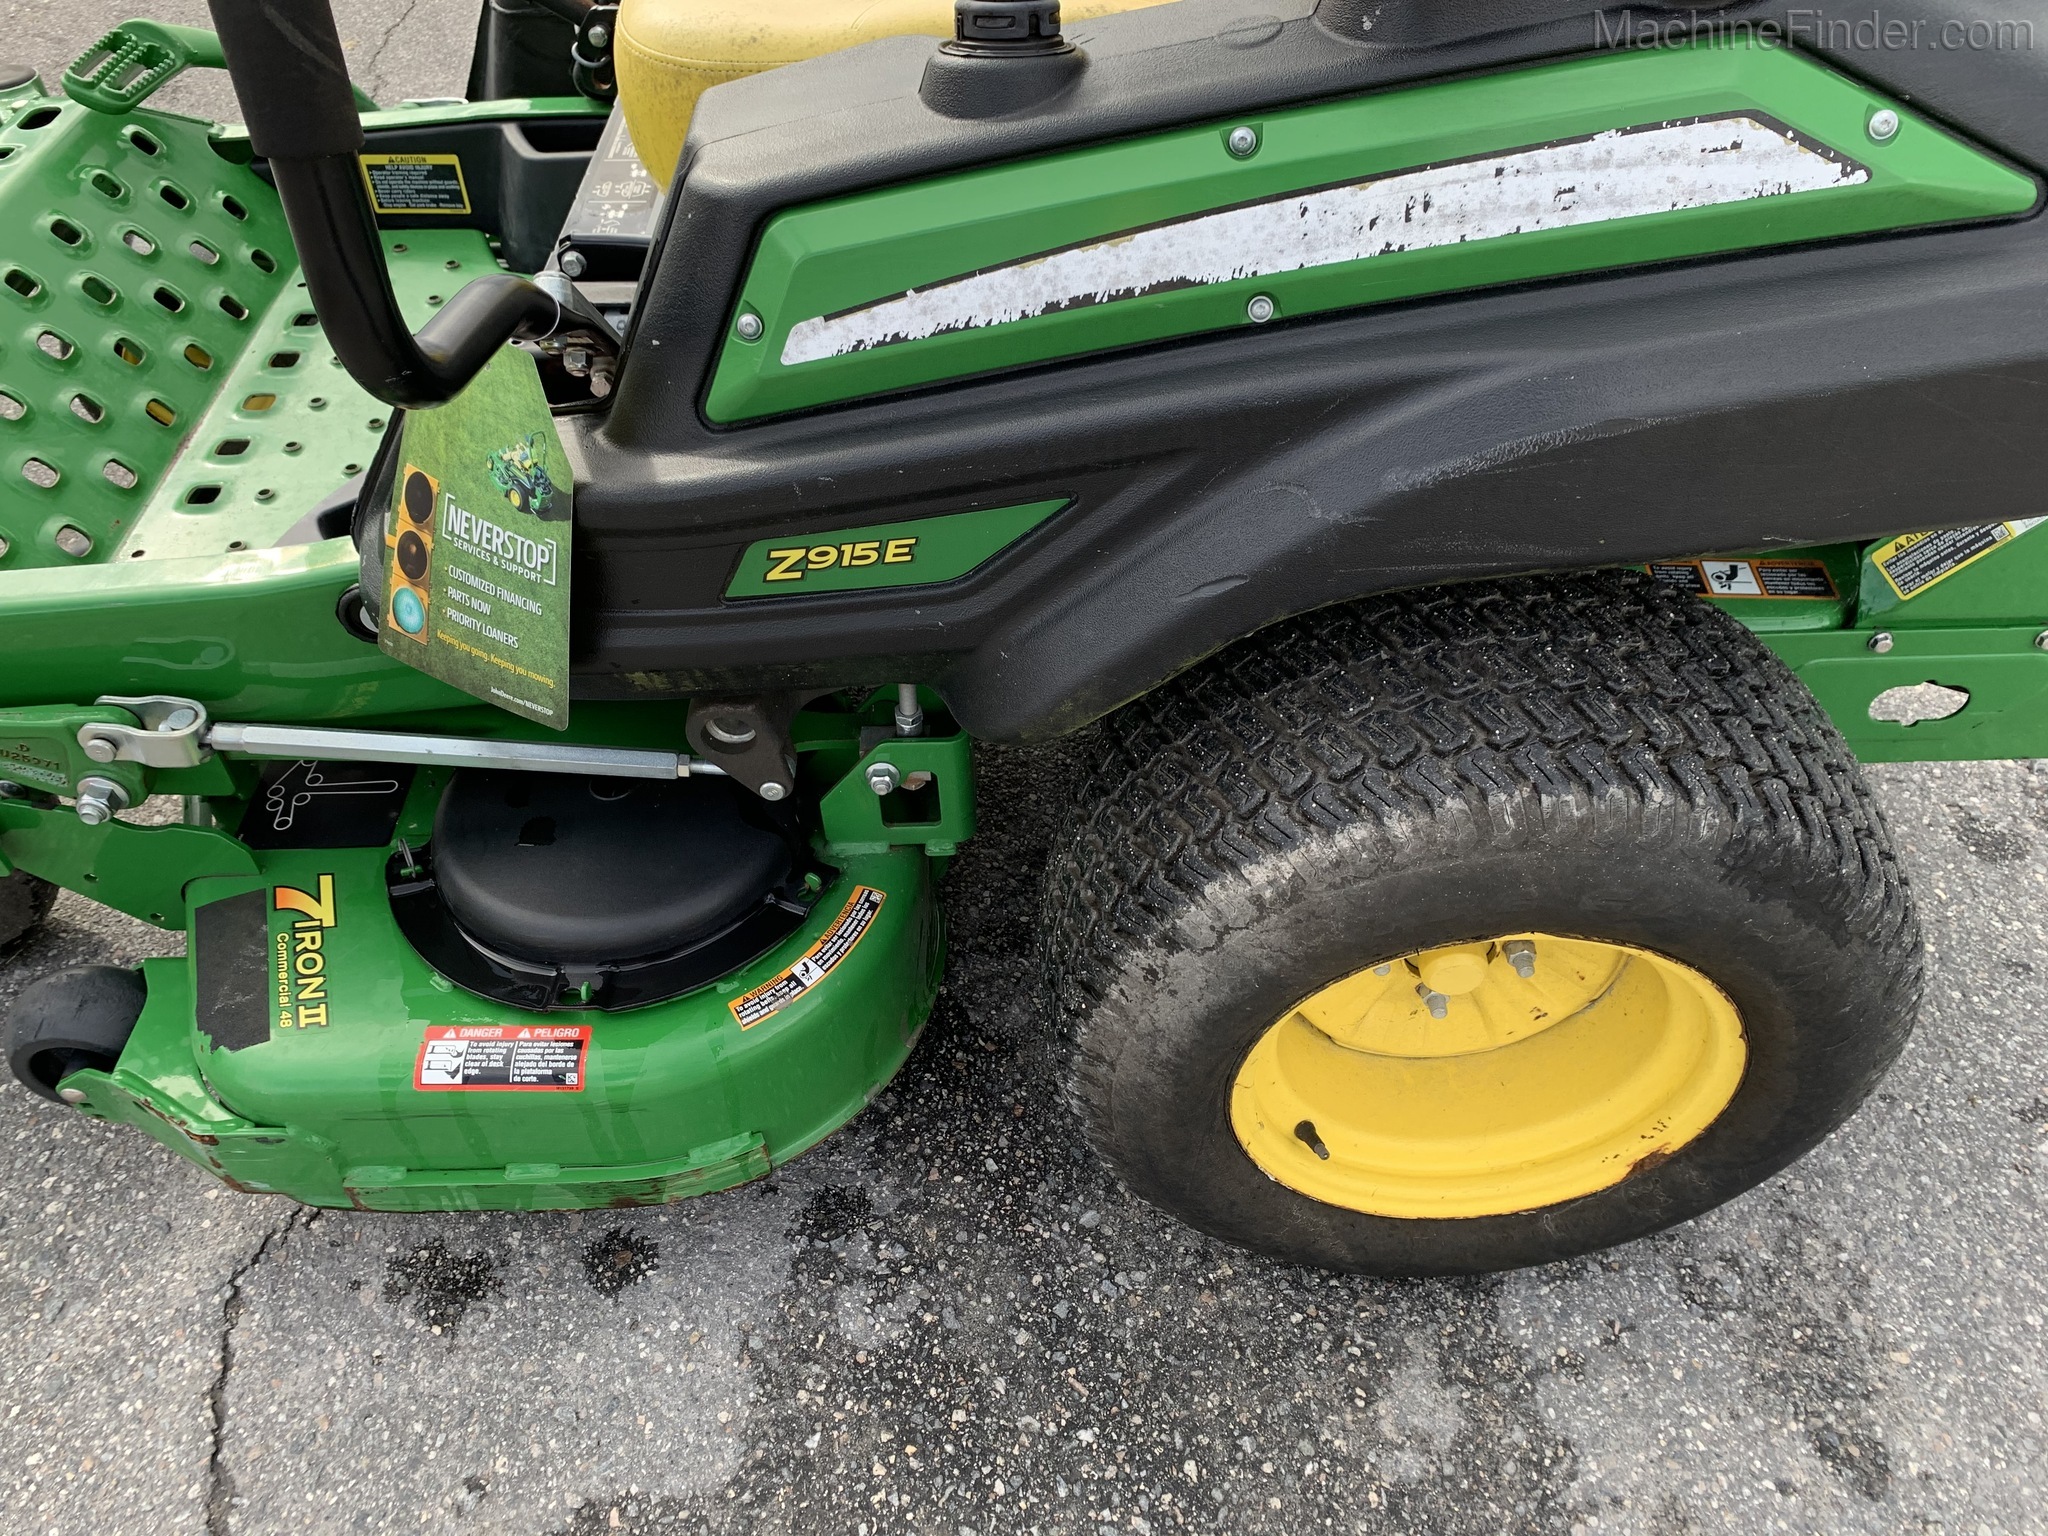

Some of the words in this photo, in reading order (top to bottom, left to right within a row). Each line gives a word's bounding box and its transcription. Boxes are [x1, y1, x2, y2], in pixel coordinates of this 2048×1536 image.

[449, 503, 550, 572] NEVERSTOP
[453, 537, 492, 562] SERVICES
[493, 557, 500, 566] &
[501, 560, 542, 583] SUPPORT
[447, 586, 471, 608] PARTS
[471, 597, 491, 616] NOW
[448, 564, 496, 597] CUSTOMIZED
[496, 587, 543, 616] FINANCING
[446, 607, 483, 634] PRIORITY
[482, 622, 519, 649] LOANERS
[436, 629, 461, 651] Keeping
[459, 642, 472, 656] you
[470, 648, 490, 664] going.
[490, 652, 518, 675] Keeping
[516, 665, 528, 679] you
[528, 671, 556, 689] mowing.
[824, 902, 855, 942] ADVERTENCIA
[276, 932, 292, 1008] Commercial
[750, 974, 784, 998] WARNING
[736, 1004, 744, 1013] To
[744, 997, 761, 1009] avoid
[759, 988, 776, 1002] injury
[774, 980, 789, 992] from
[738, 1003, 762, 1019] rotating
[788, 980, 798, 989] all
[759, 1005, 770, 1017] and
[279, 1010, 293, 1029] 48
[458, 1028, 504, 1038] DANGER
[534, 1028, 580, 1038] PELIGRO
[496, 1040, 515, 1048] injury
[463, 1068, 482, 1076] edge.
